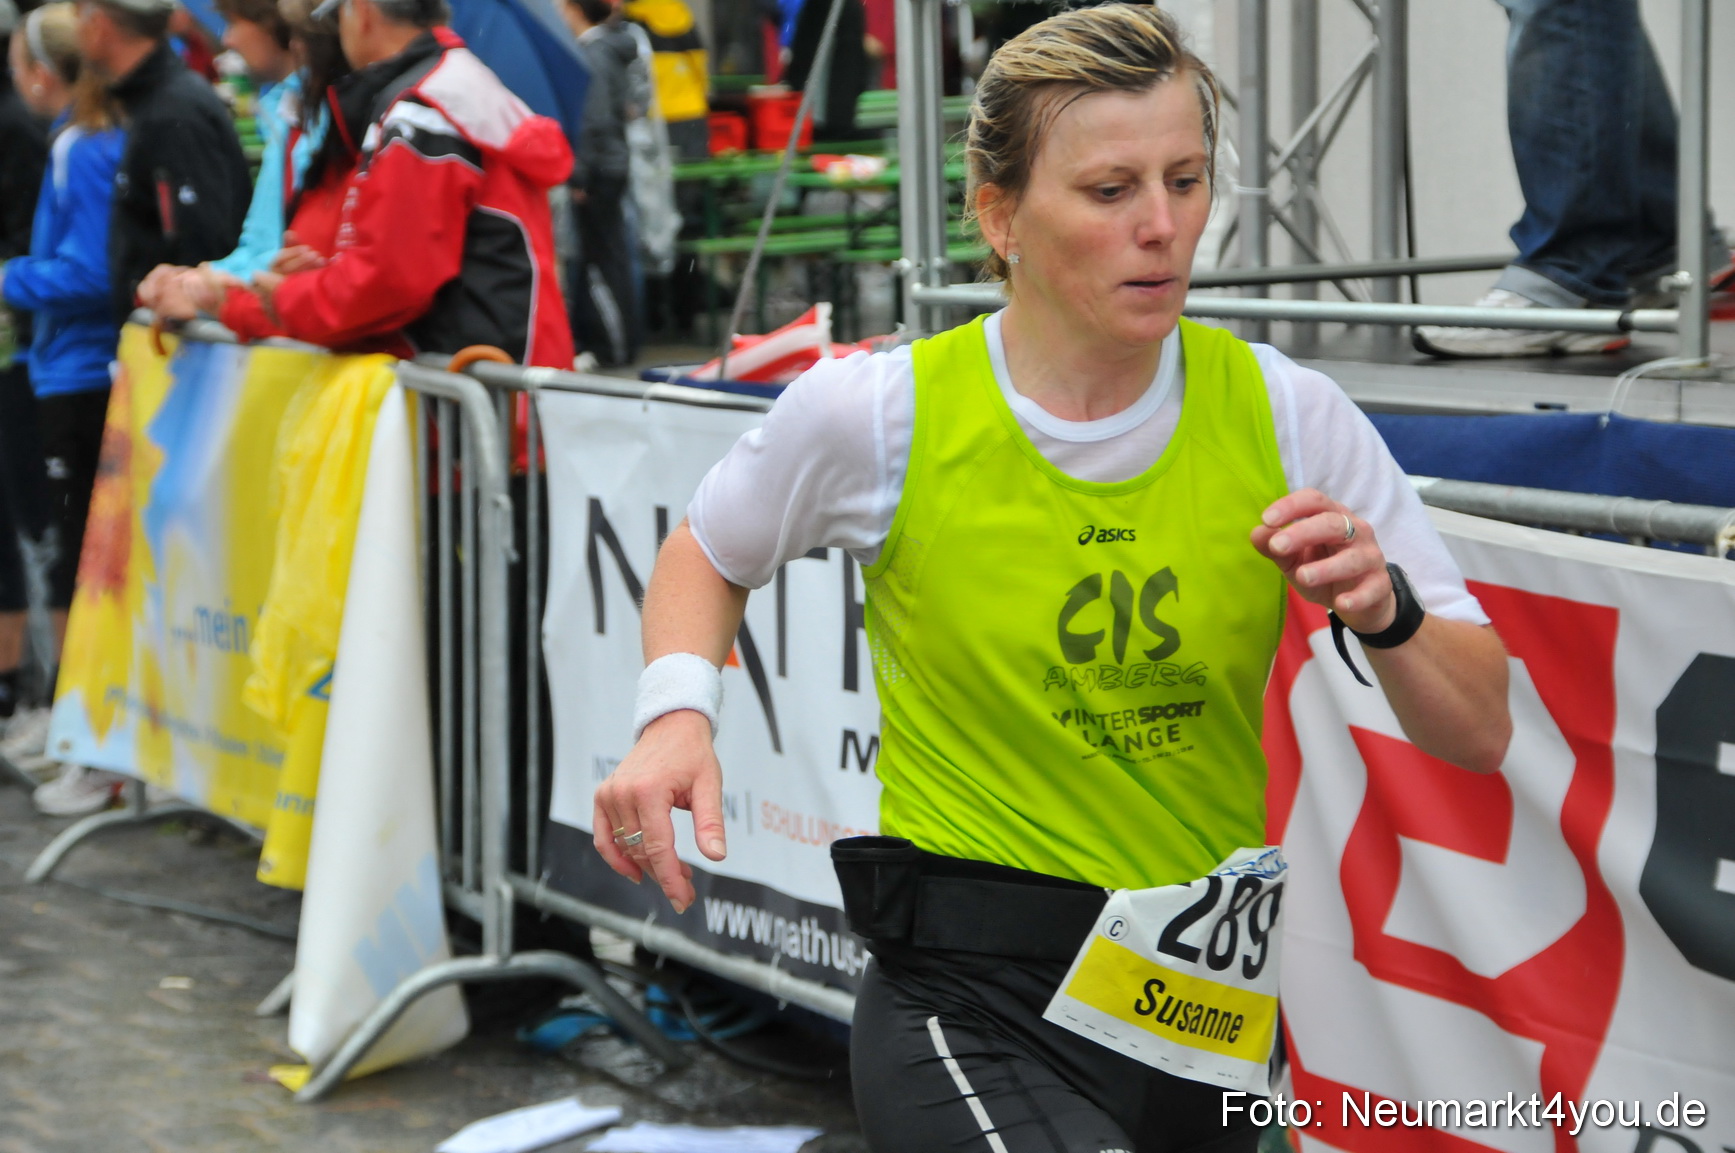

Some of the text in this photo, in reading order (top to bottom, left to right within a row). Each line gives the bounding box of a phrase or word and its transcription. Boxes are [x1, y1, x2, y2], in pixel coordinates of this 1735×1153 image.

[1096, 528, 1136, 543] asics
[1043, 661, 1209, 692] AMBERG
[1082, 723, 1181, 754] LANGE
[1157, 875, 1284, 980] 289
[1134, 978, 1244, 1044] Susanne
